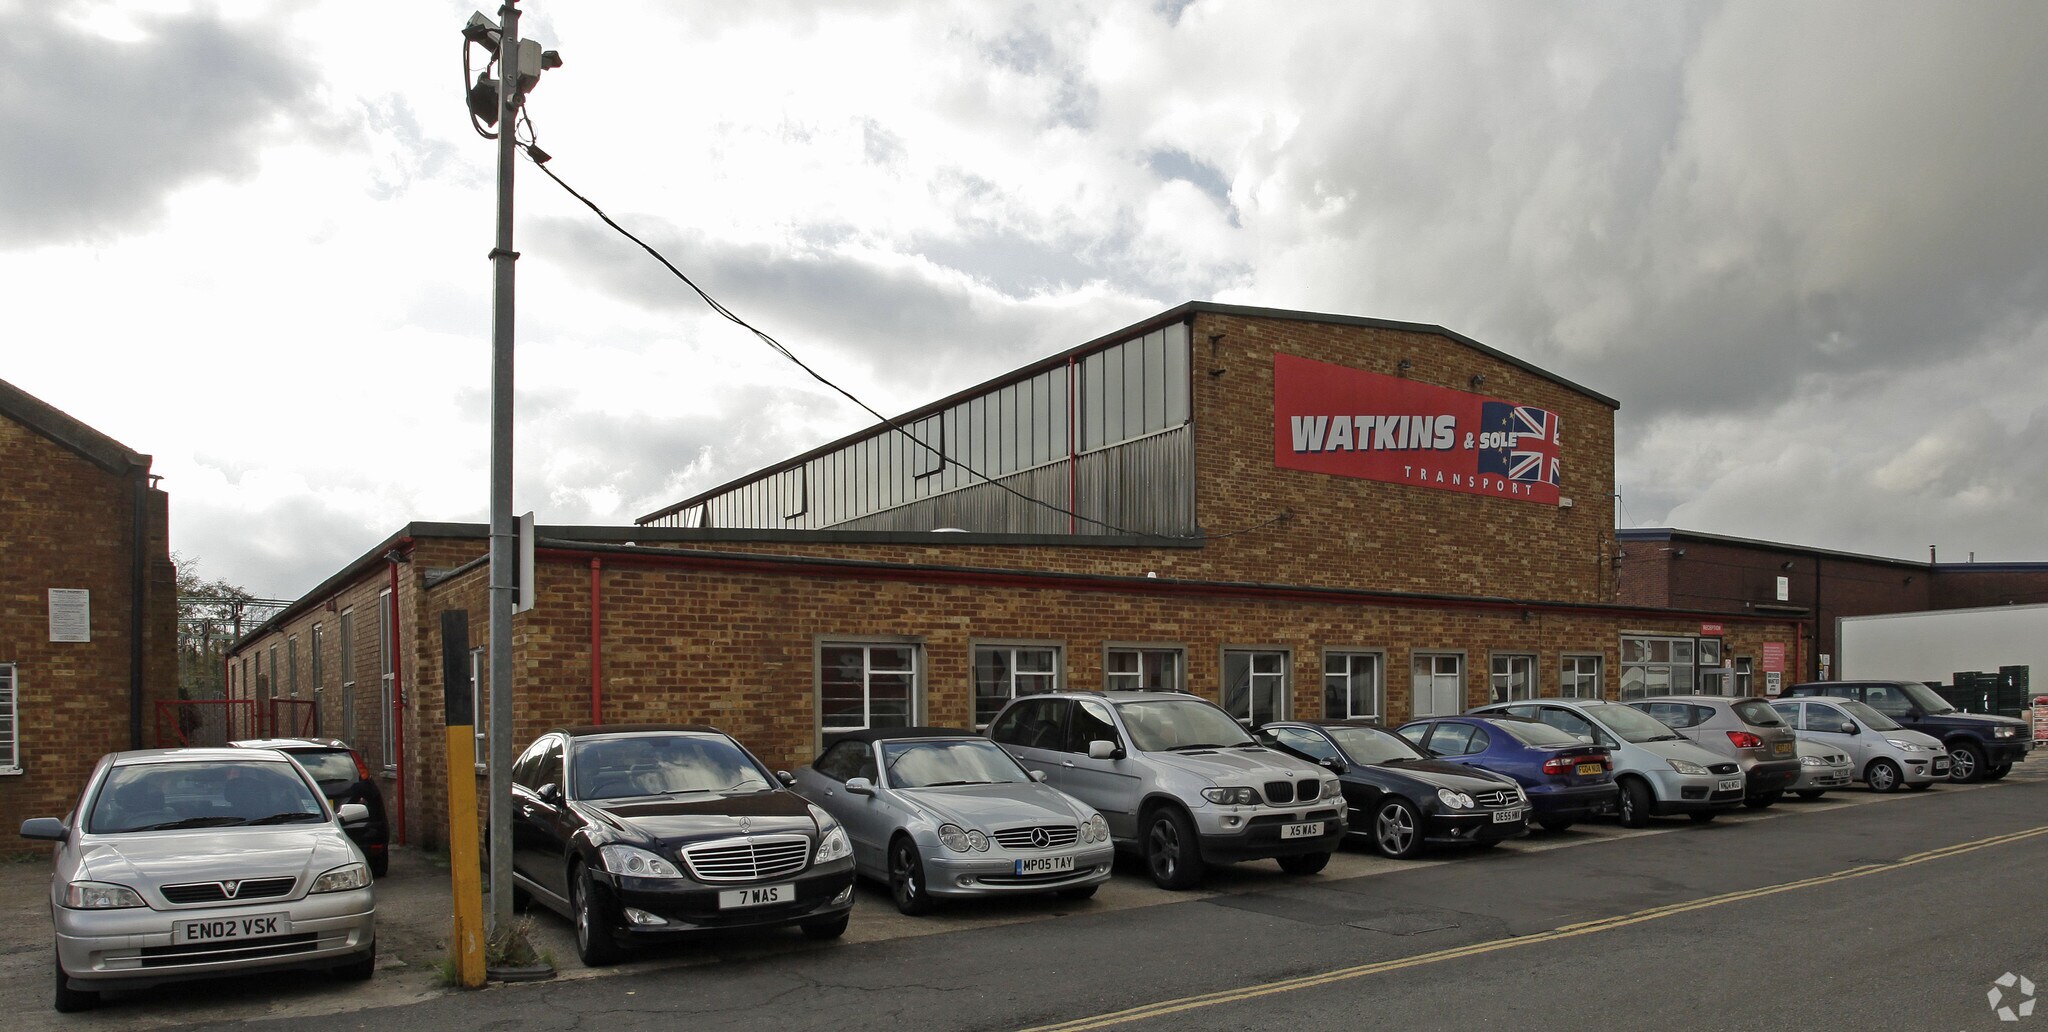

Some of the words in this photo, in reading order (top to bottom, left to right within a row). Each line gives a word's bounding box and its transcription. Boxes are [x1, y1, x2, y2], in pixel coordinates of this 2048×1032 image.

[1290, 414, 1456, 453] WATKINS
[1463, 431, 1475, 449] &
[1479, 431, 1518, 449] SOLE
[1404, 465, 1532, 496] TRANSPORT
[1495, 811, 1511, 822] OE55
[1290, 826, 1301, 836] X5
[1302, 824, 1317, 835] WAS
[1023, 858, 1052, 872] MP05
[1054, 856, 1072, 869] TAY
[740, 891, 748, 904] 7
[752, 887, 778, 904] WAS
[187, 921, 237, 940] EN02
[243, 917, 277, 935] VSK
